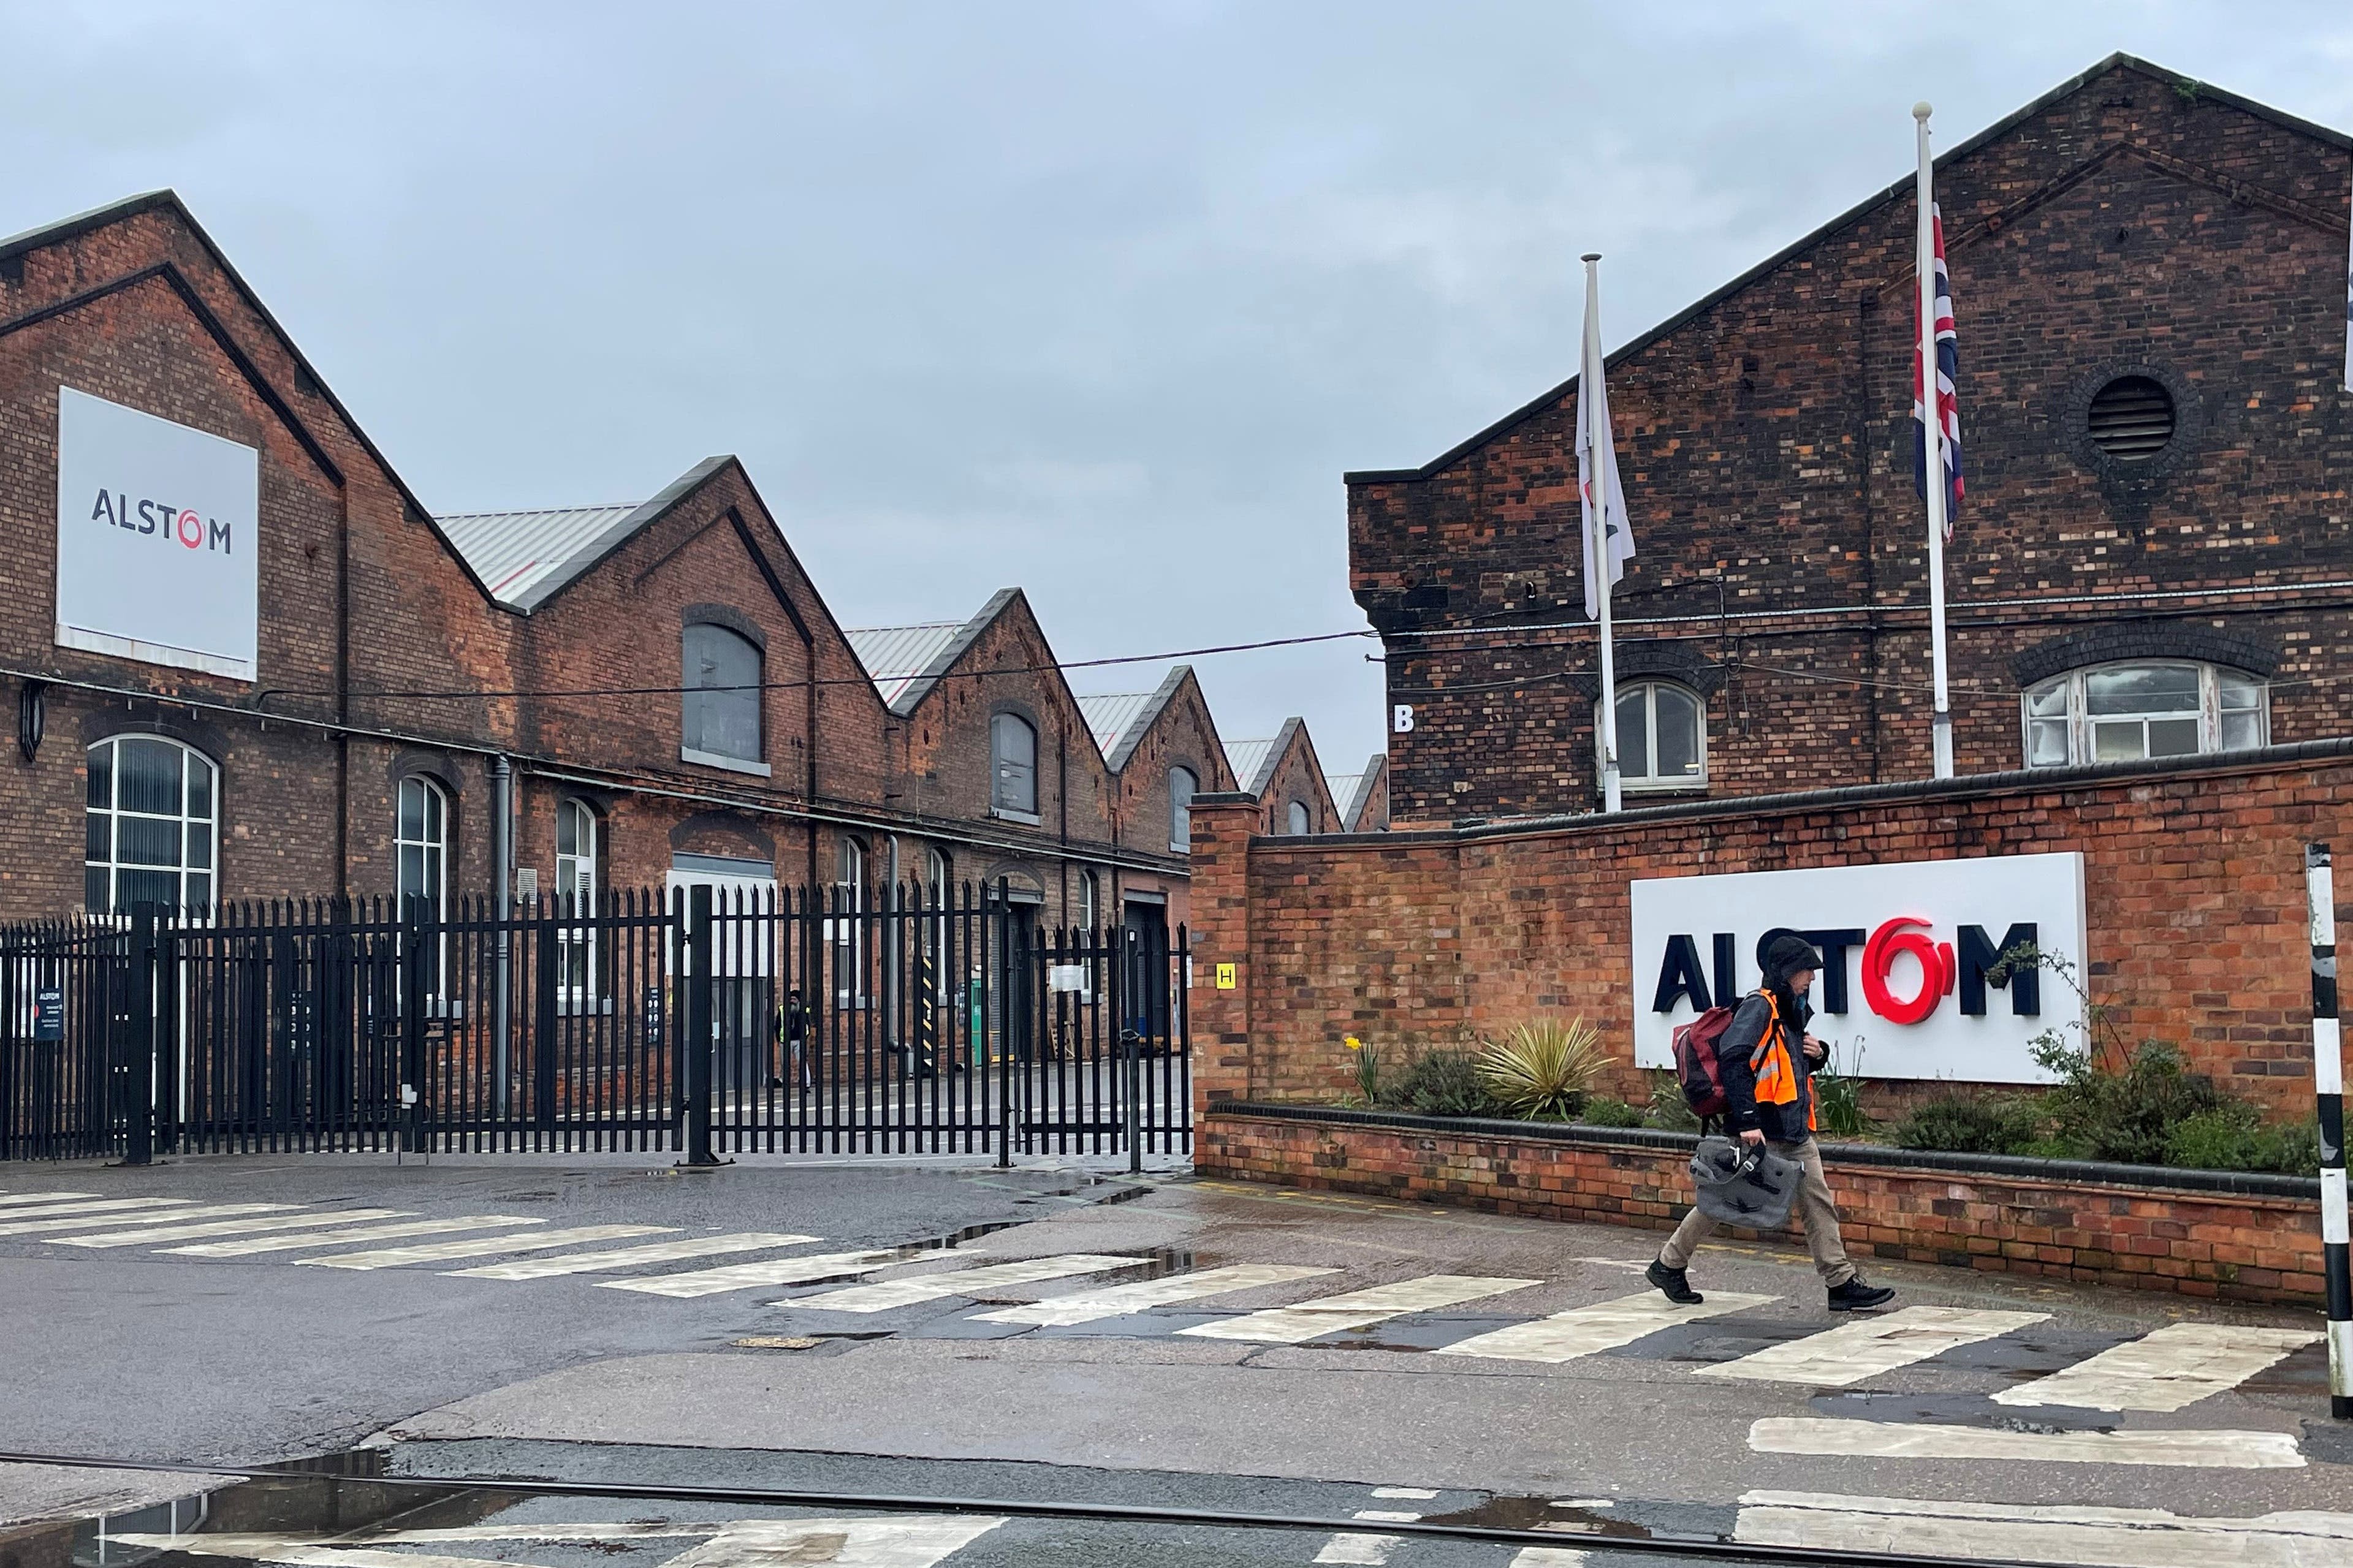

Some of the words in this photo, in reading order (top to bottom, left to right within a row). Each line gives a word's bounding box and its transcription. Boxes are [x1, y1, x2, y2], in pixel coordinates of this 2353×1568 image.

[92, 488, 230, 554] ALSTOM
[1394, 705, 1414, 732] B
[1220, 969, 1231, 983] H
